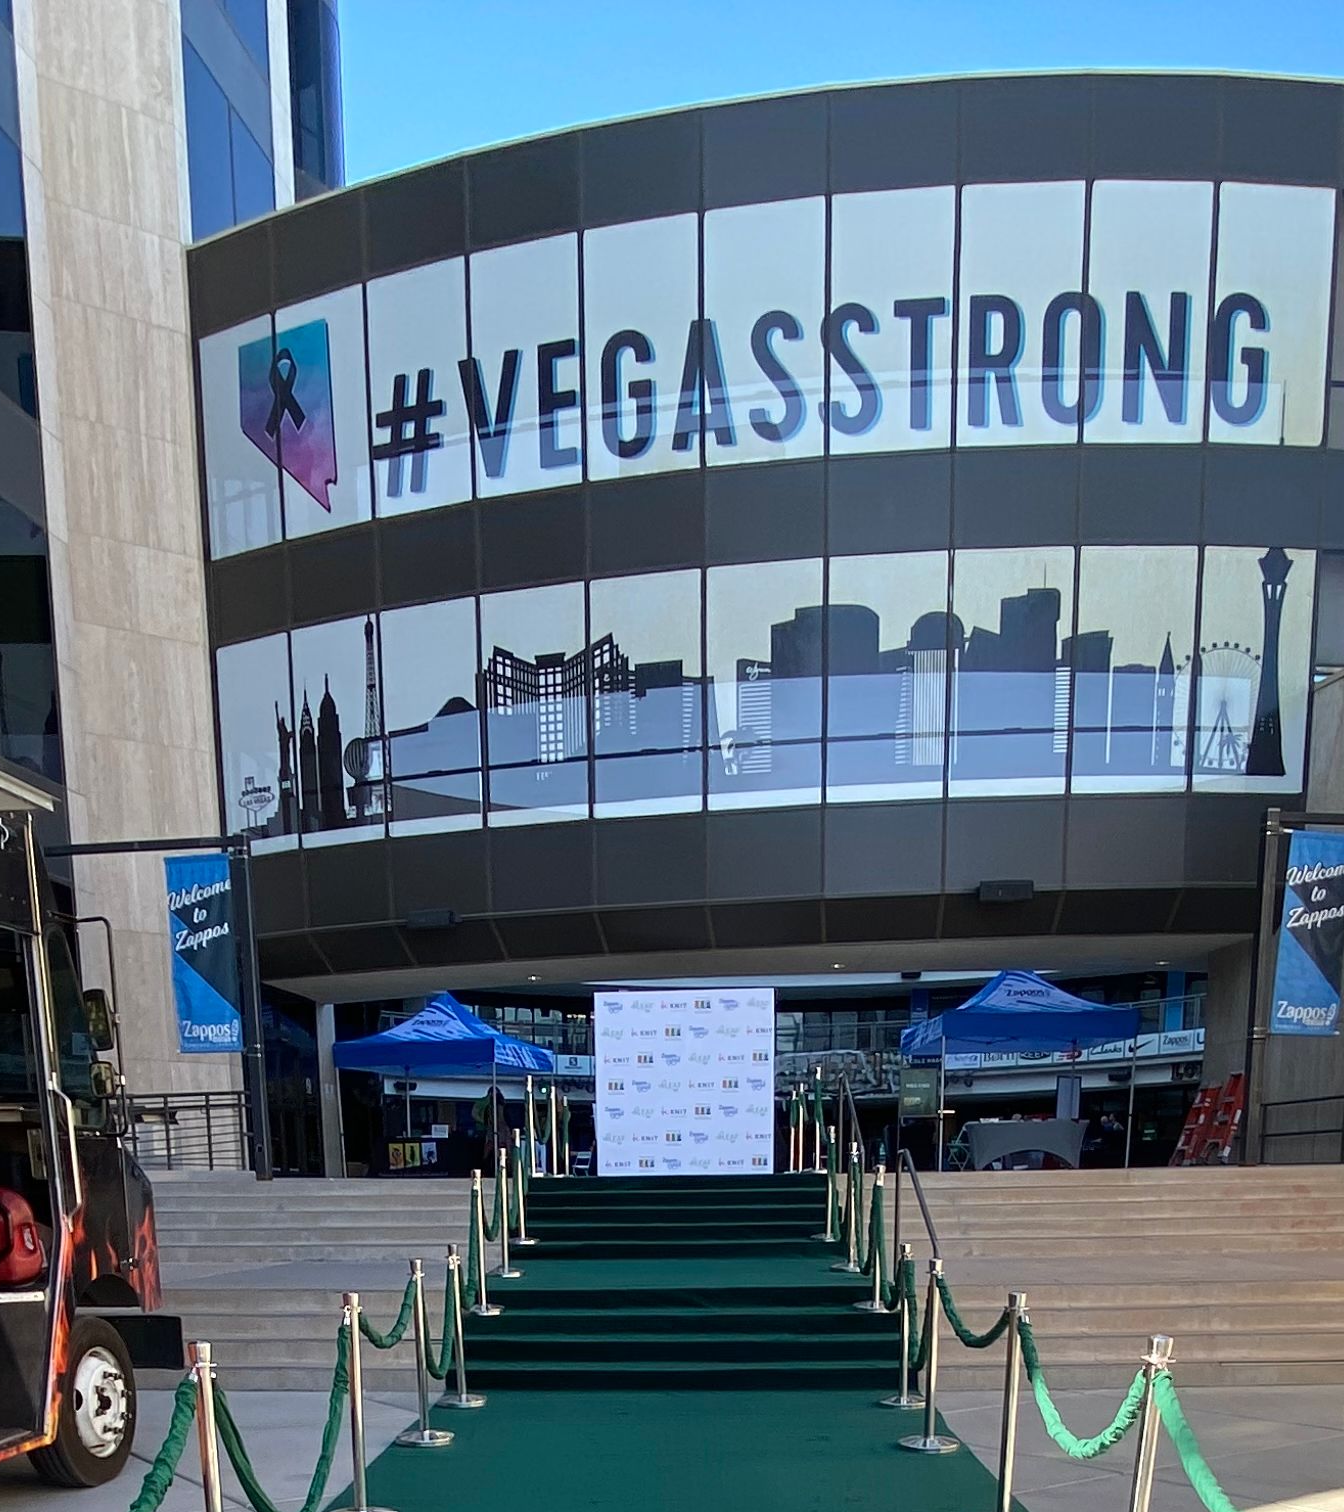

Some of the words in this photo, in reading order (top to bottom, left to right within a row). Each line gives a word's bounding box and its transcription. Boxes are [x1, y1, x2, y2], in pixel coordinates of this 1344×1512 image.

[372, 291, 1270, 496] #VEGASSTRONG
[167, 878, 232, 911] Welcome
[1311, 885, 1327, 902] to
[193, 907, 207, 923] to
[1286, 905, 1344, 930] Zappos
[175, 922, 229, 951] Zappos
